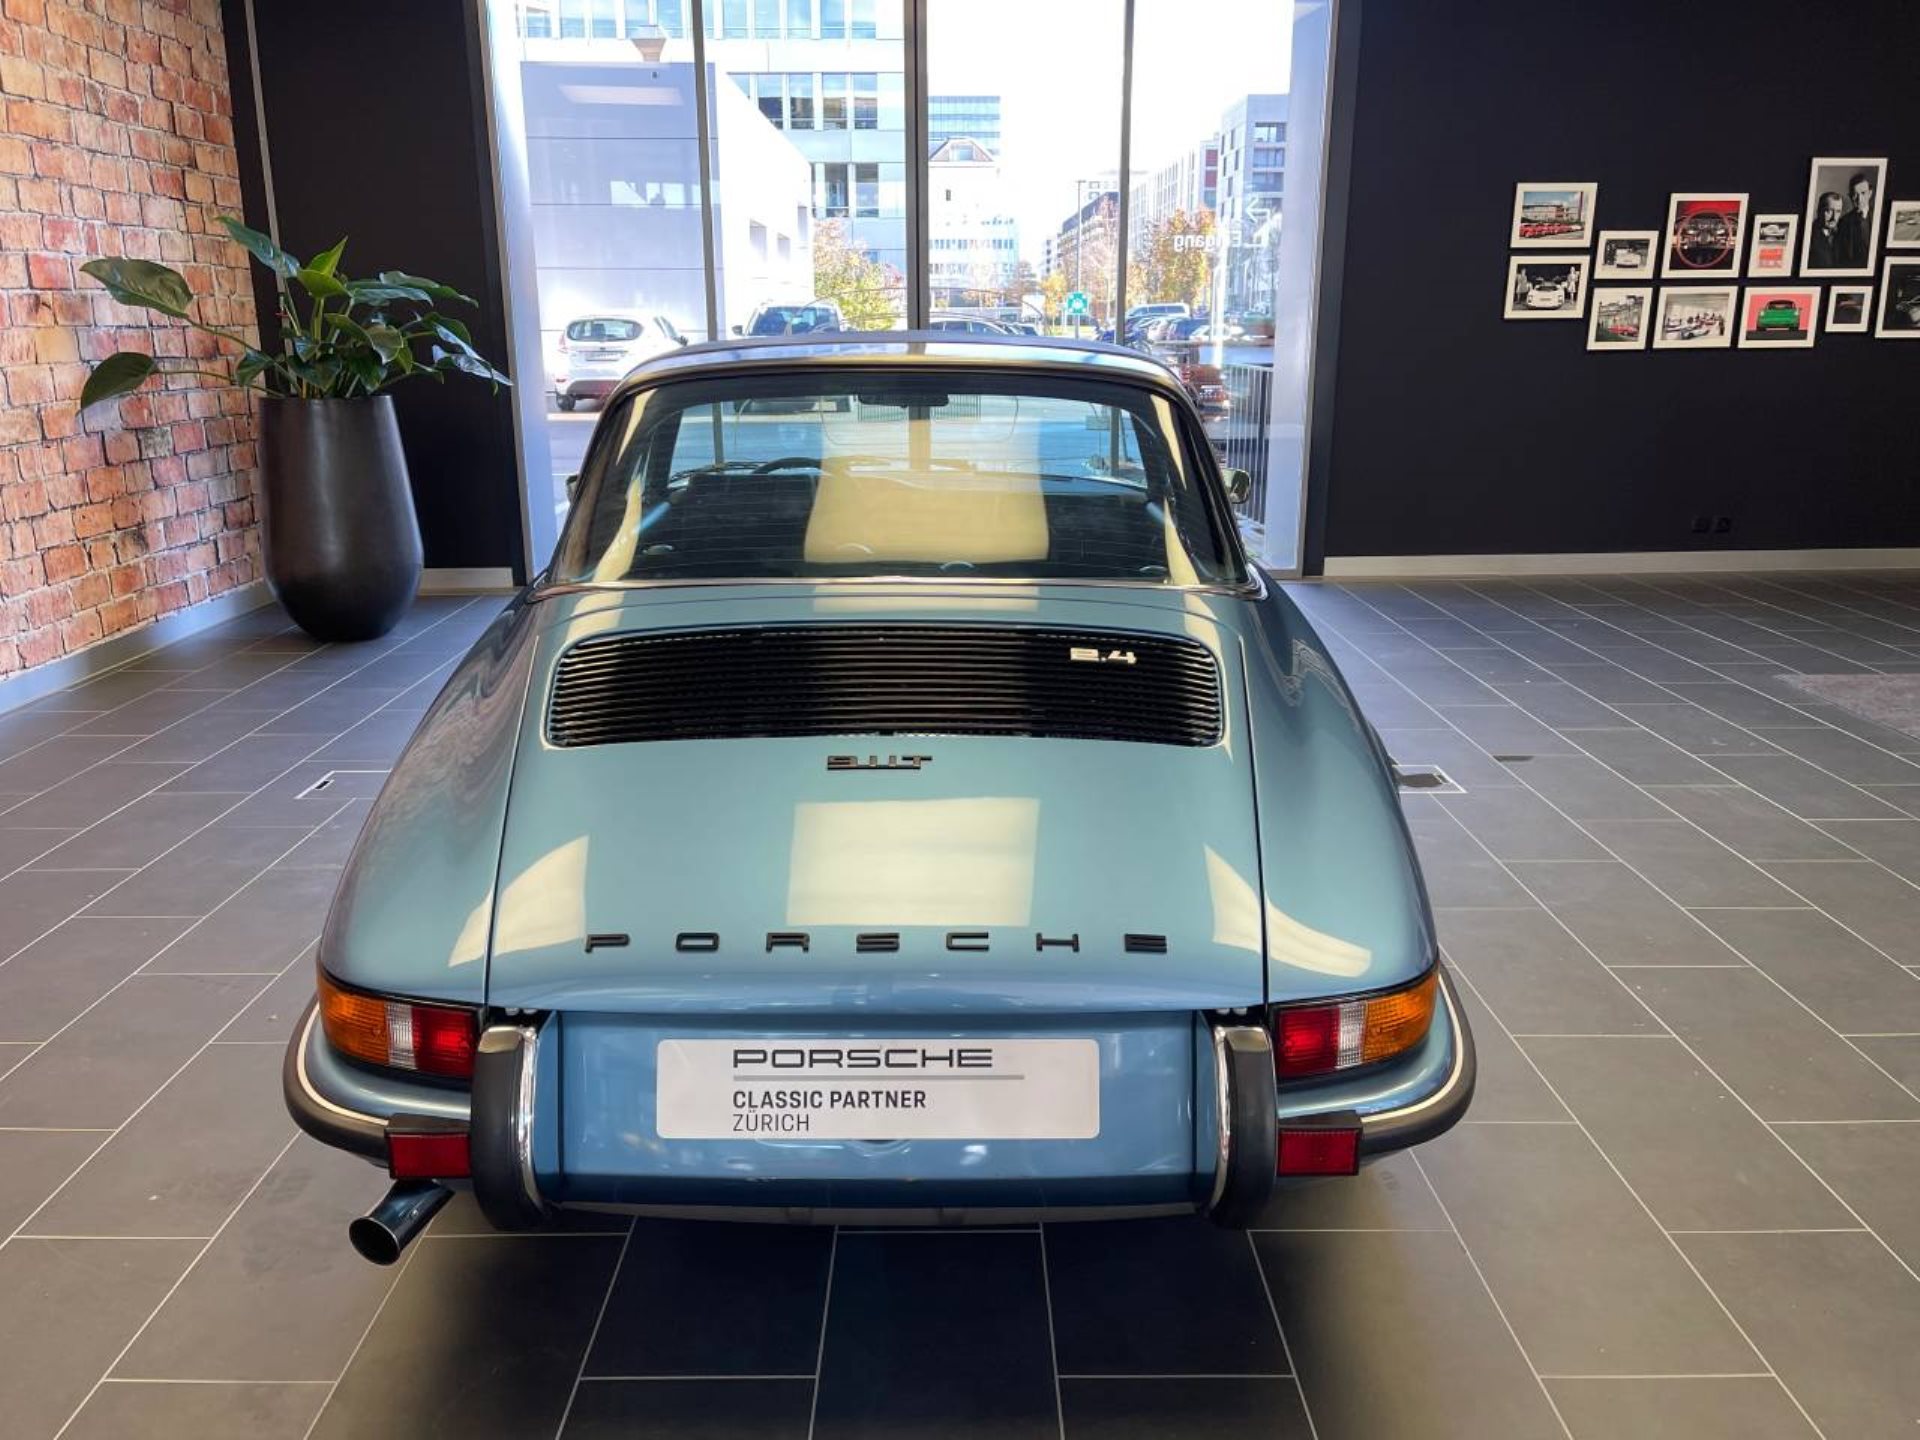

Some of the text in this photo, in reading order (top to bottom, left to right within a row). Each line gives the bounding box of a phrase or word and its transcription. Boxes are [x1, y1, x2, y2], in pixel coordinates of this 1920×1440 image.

[585, 932, 1168, 954] PORSCHE
[732, 1049, 993, 1068] PORSCHE
[732, 1090, 926, 1109] CLASSIC PARTNER
[732, 1110, 810, 1132] ZÜRICH
